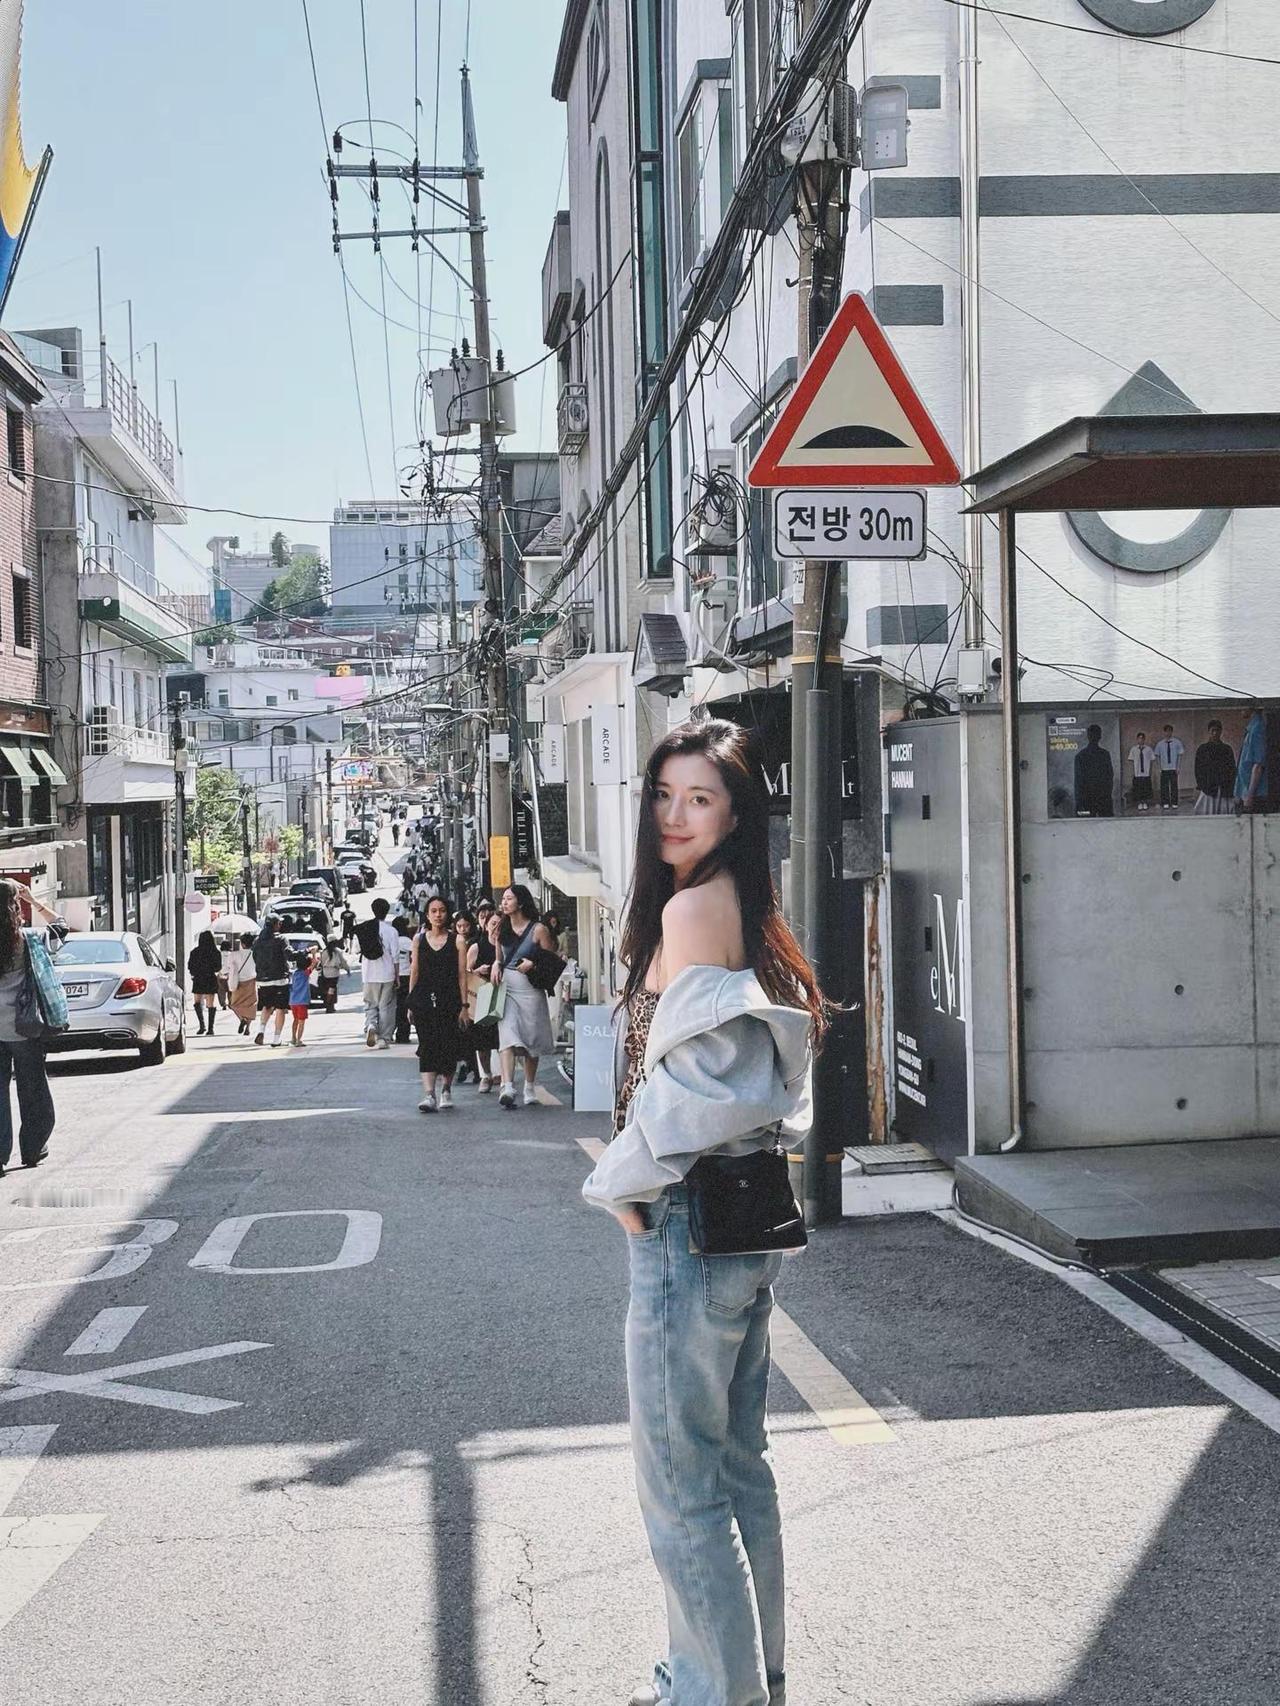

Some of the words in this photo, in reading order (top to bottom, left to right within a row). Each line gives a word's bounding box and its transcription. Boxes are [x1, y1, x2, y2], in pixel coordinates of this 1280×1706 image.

[788, 506, 850, 542] 전방
[859, 507, 913, 541] 30m
[602, 727, 610, 765] ARCADE
[64, 985, 83, 995] 074
